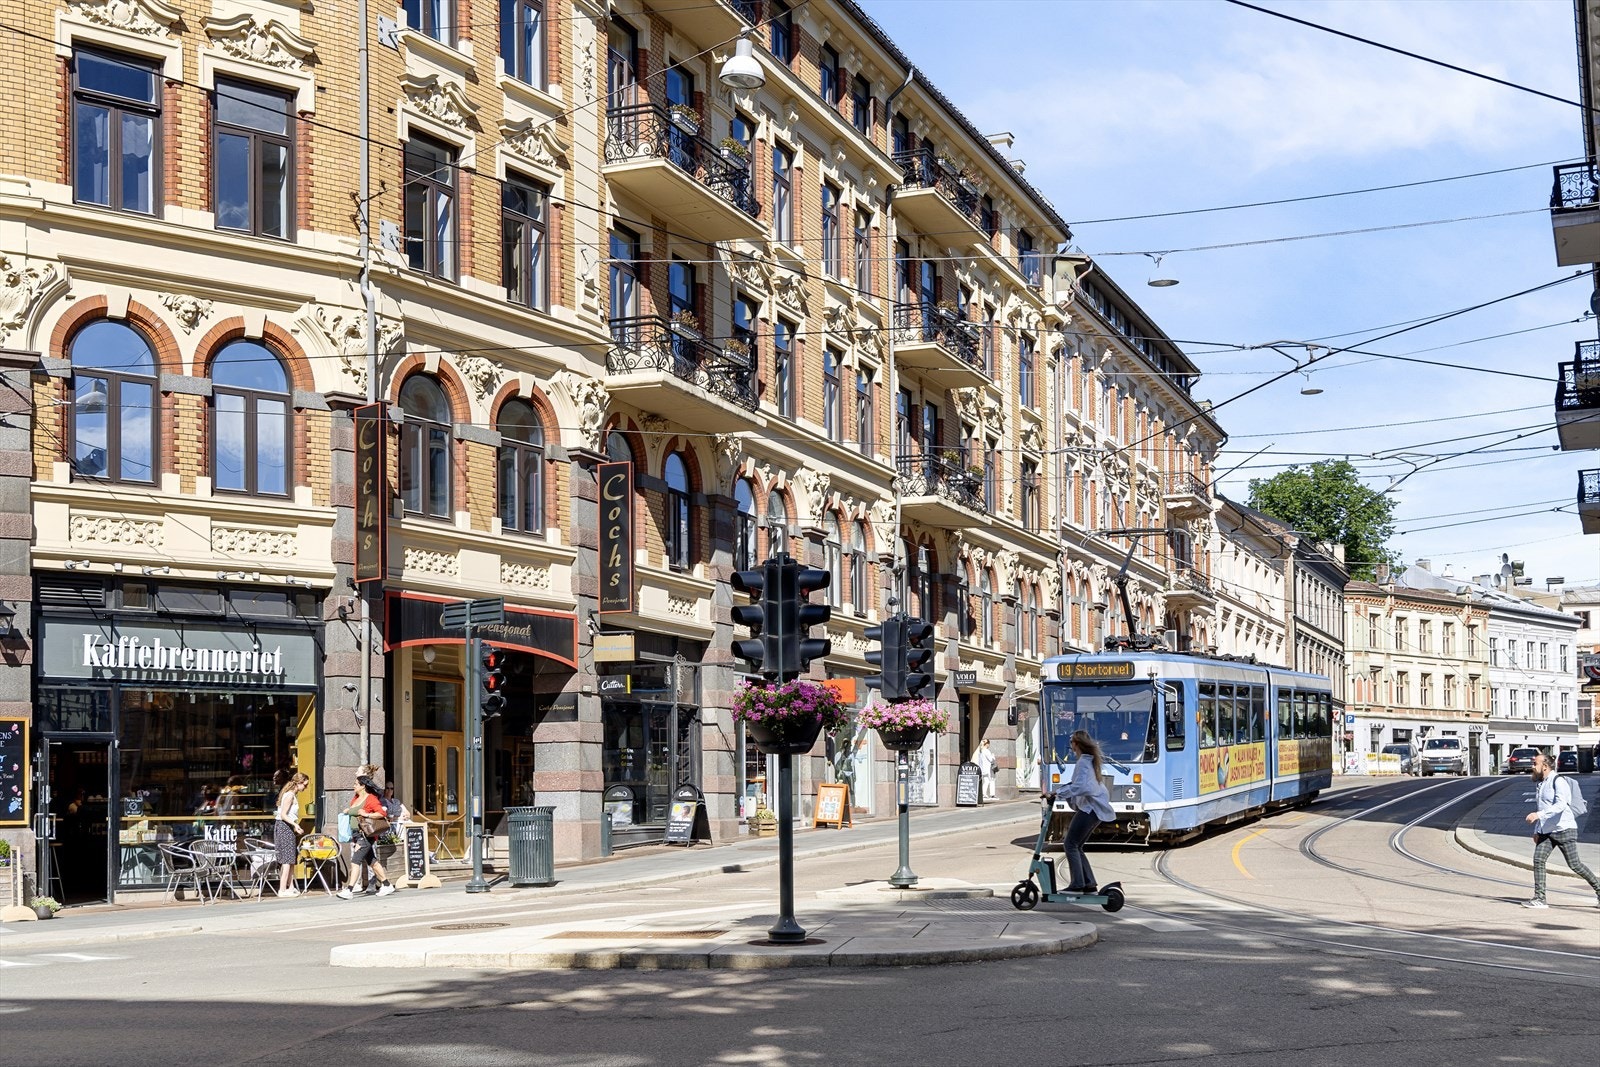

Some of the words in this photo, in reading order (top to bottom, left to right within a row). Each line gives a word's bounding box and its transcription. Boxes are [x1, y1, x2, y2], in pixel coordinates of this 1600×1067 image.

[359, 418, 376, 550] Cochs
[603, 473, 626, 587] Cochs
[82, 633, 283, 676] Kaffebrenneriet
[1061, 664, 1071, 676] 19
[204, 825, 237, 842] Kaffe
